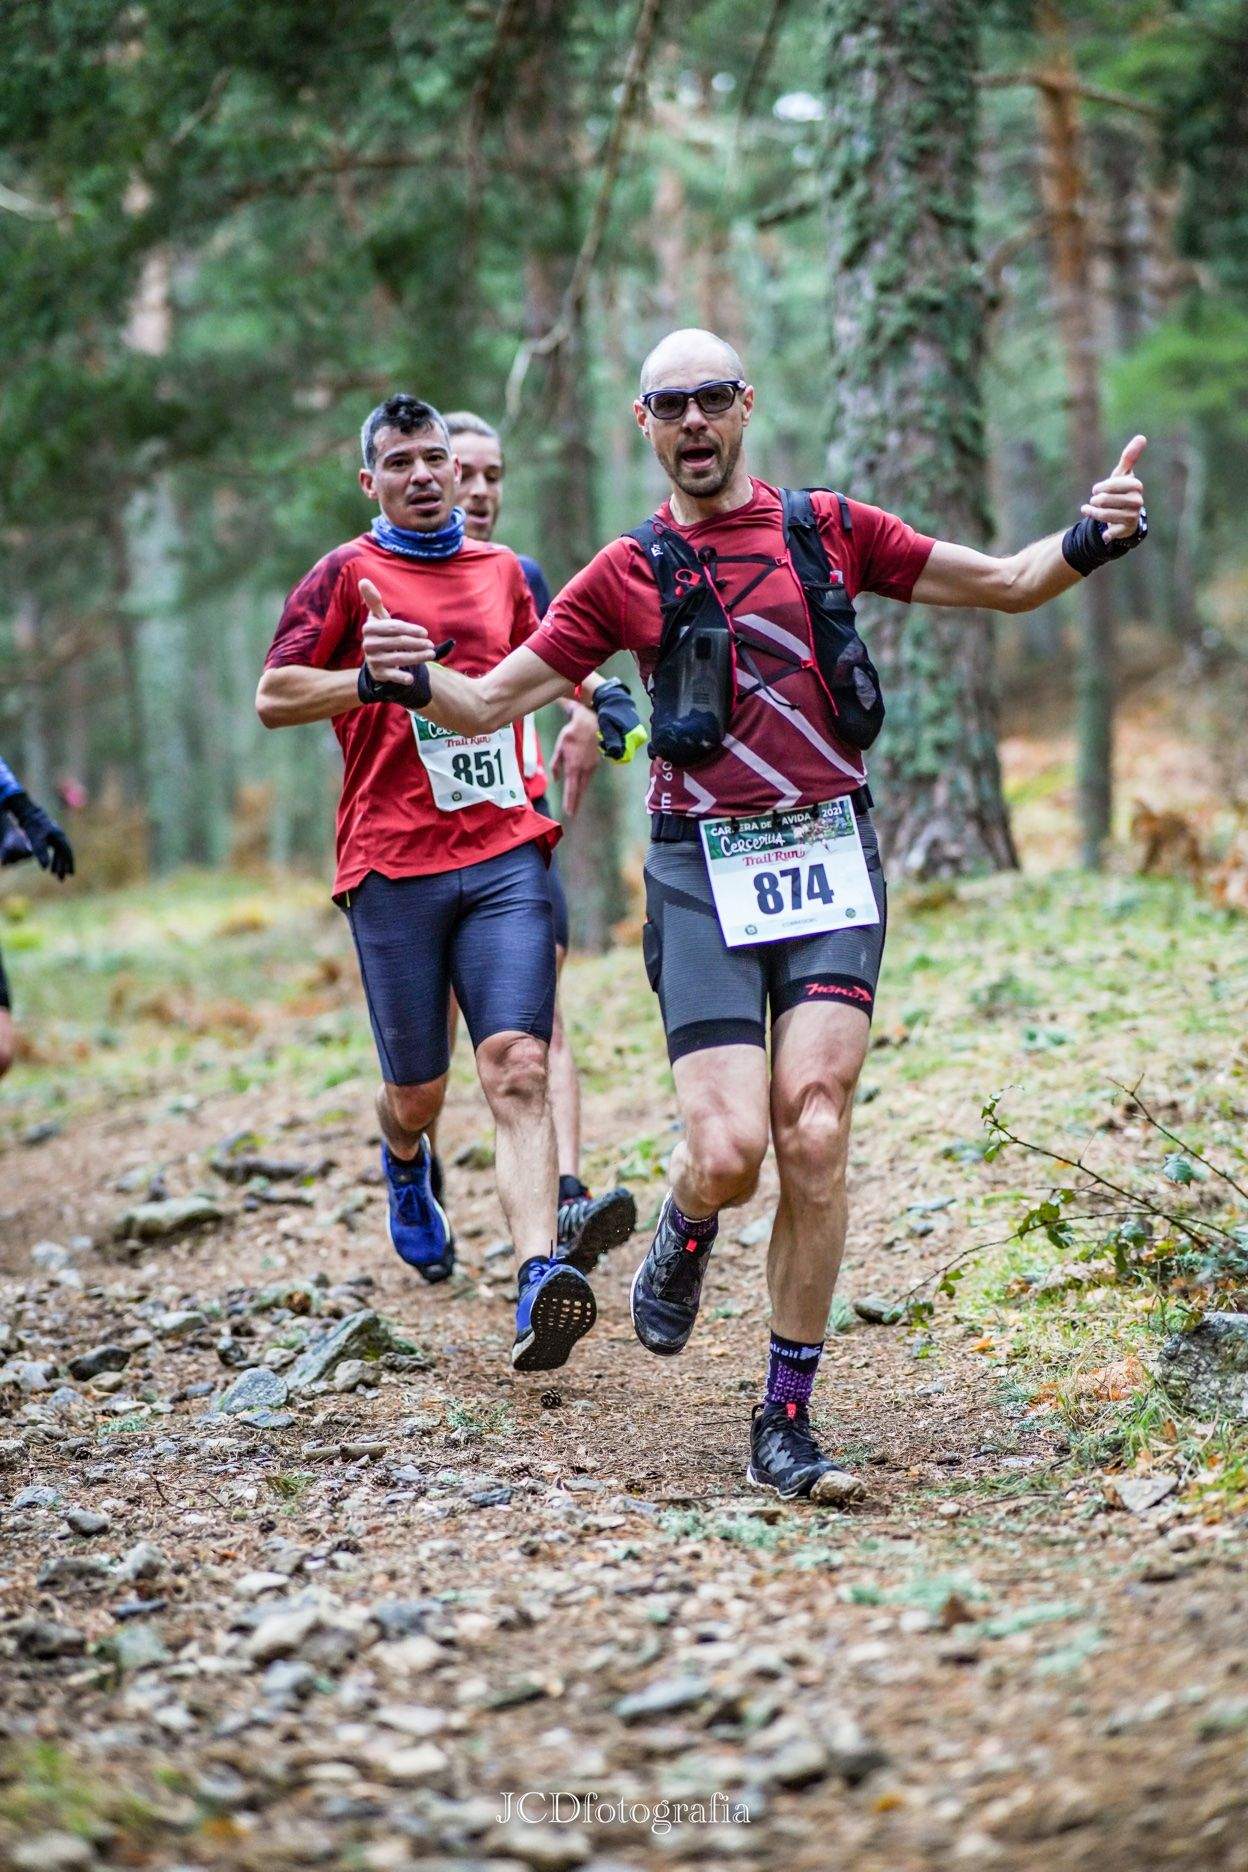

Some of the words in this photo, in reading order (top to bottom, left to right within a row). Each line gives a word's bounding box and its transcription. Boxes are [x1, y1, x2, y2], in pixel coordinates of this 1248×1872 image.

[445, 739, 468, 747] Trail
[470, 736, 491, 745] Run
[452, 748, 504, 788] 851
[710, 822, 759, 837] CARERA
[760, 820, 772, 829] DE
[778, 812, 814, 825] AVIDA
[822, 806, 842, 818] 2021
[742, 854, 771, 867] Trail
[773, 850, 805, 861] Run
[753, 863, 835, 915] 874
